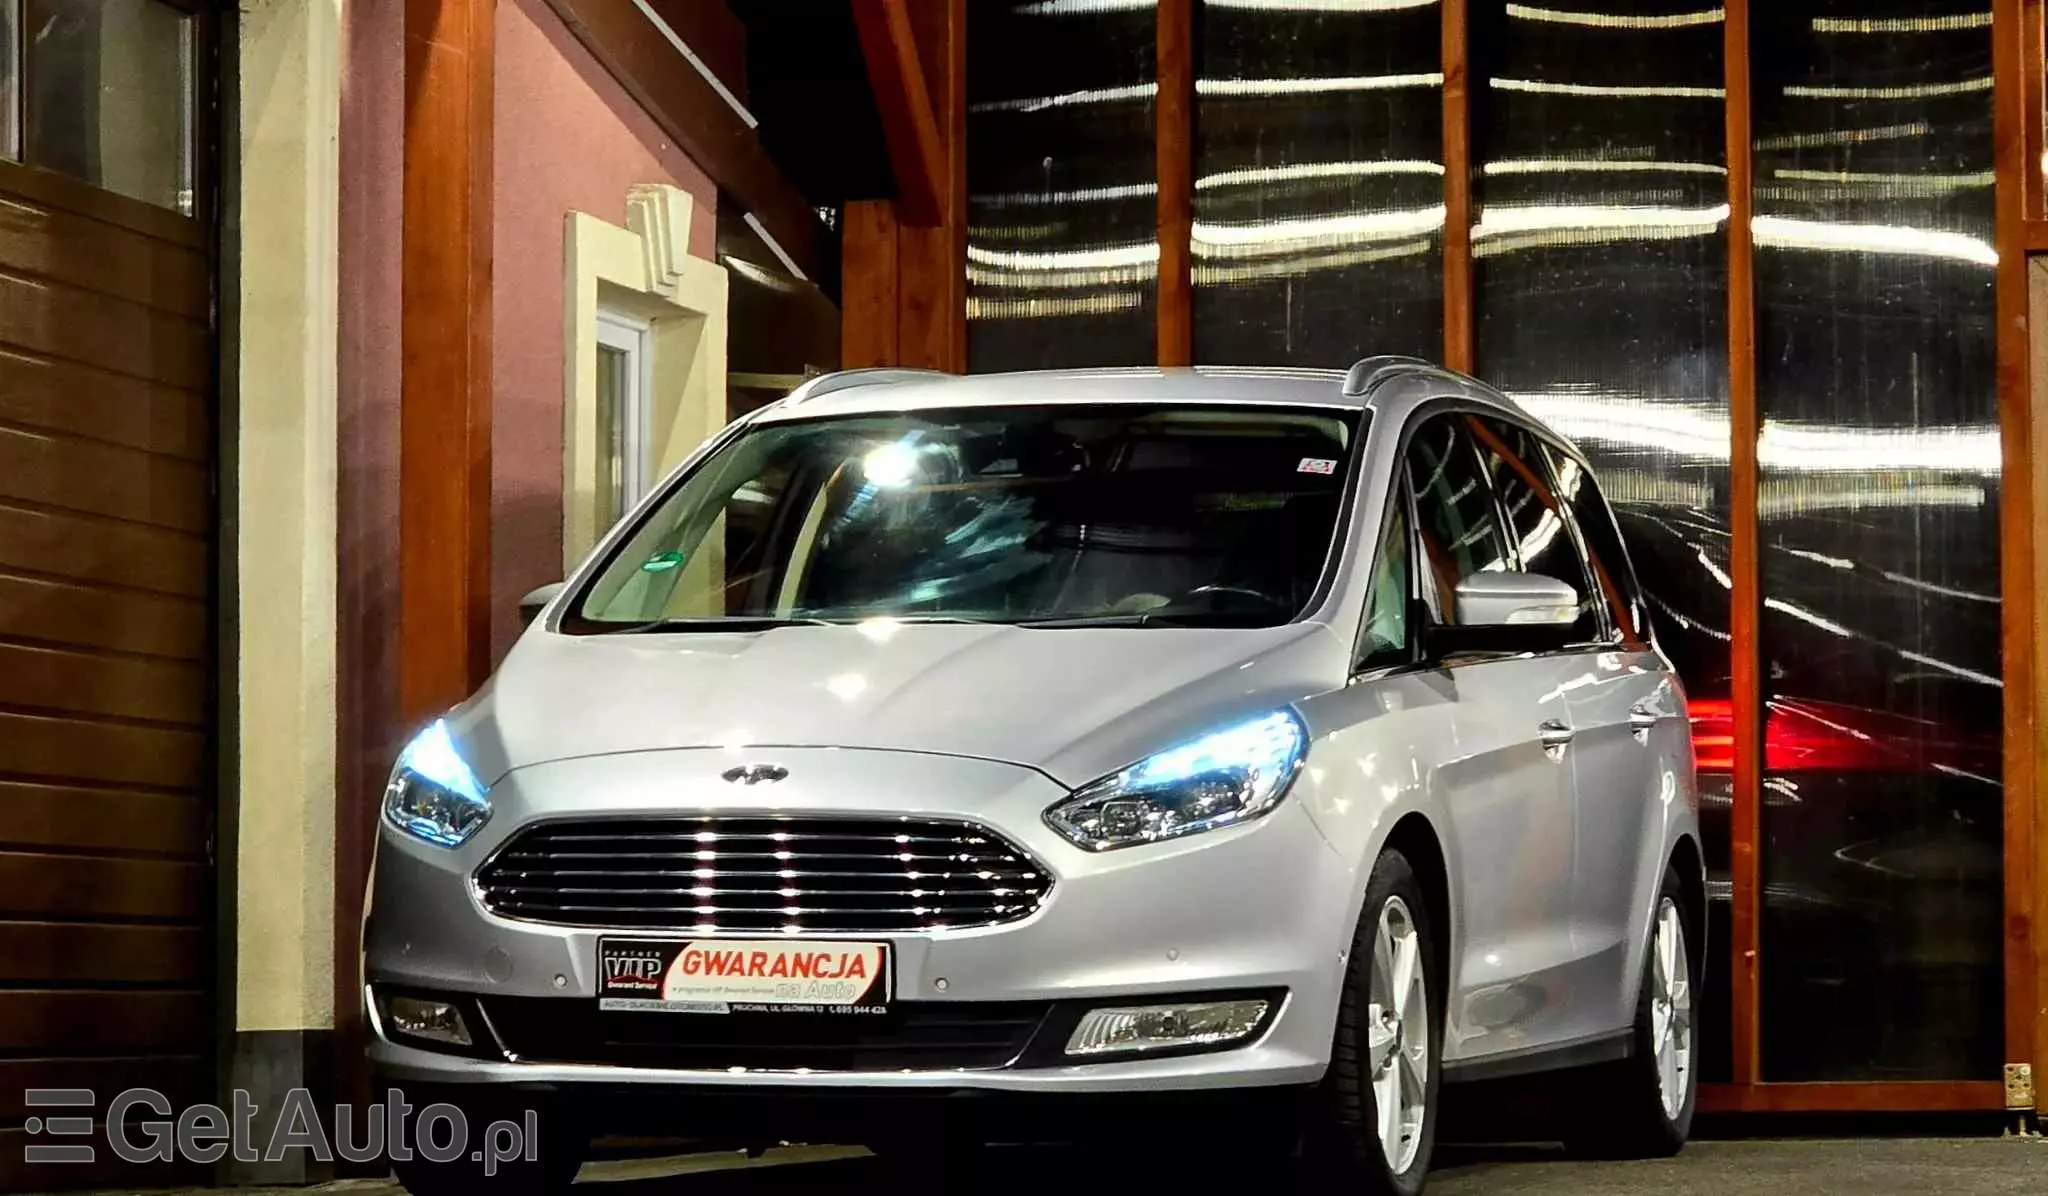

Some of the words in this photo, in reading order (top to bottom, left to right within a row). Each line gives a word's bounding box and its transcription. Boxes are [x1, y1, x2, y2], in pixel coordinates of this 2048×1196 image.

[604, 957, 662, 980] VIP
[682, 949, 866, 979] GWARANCJA
[775, 982, 801, 999] na
[803, 980, 857, 1000] Auto
